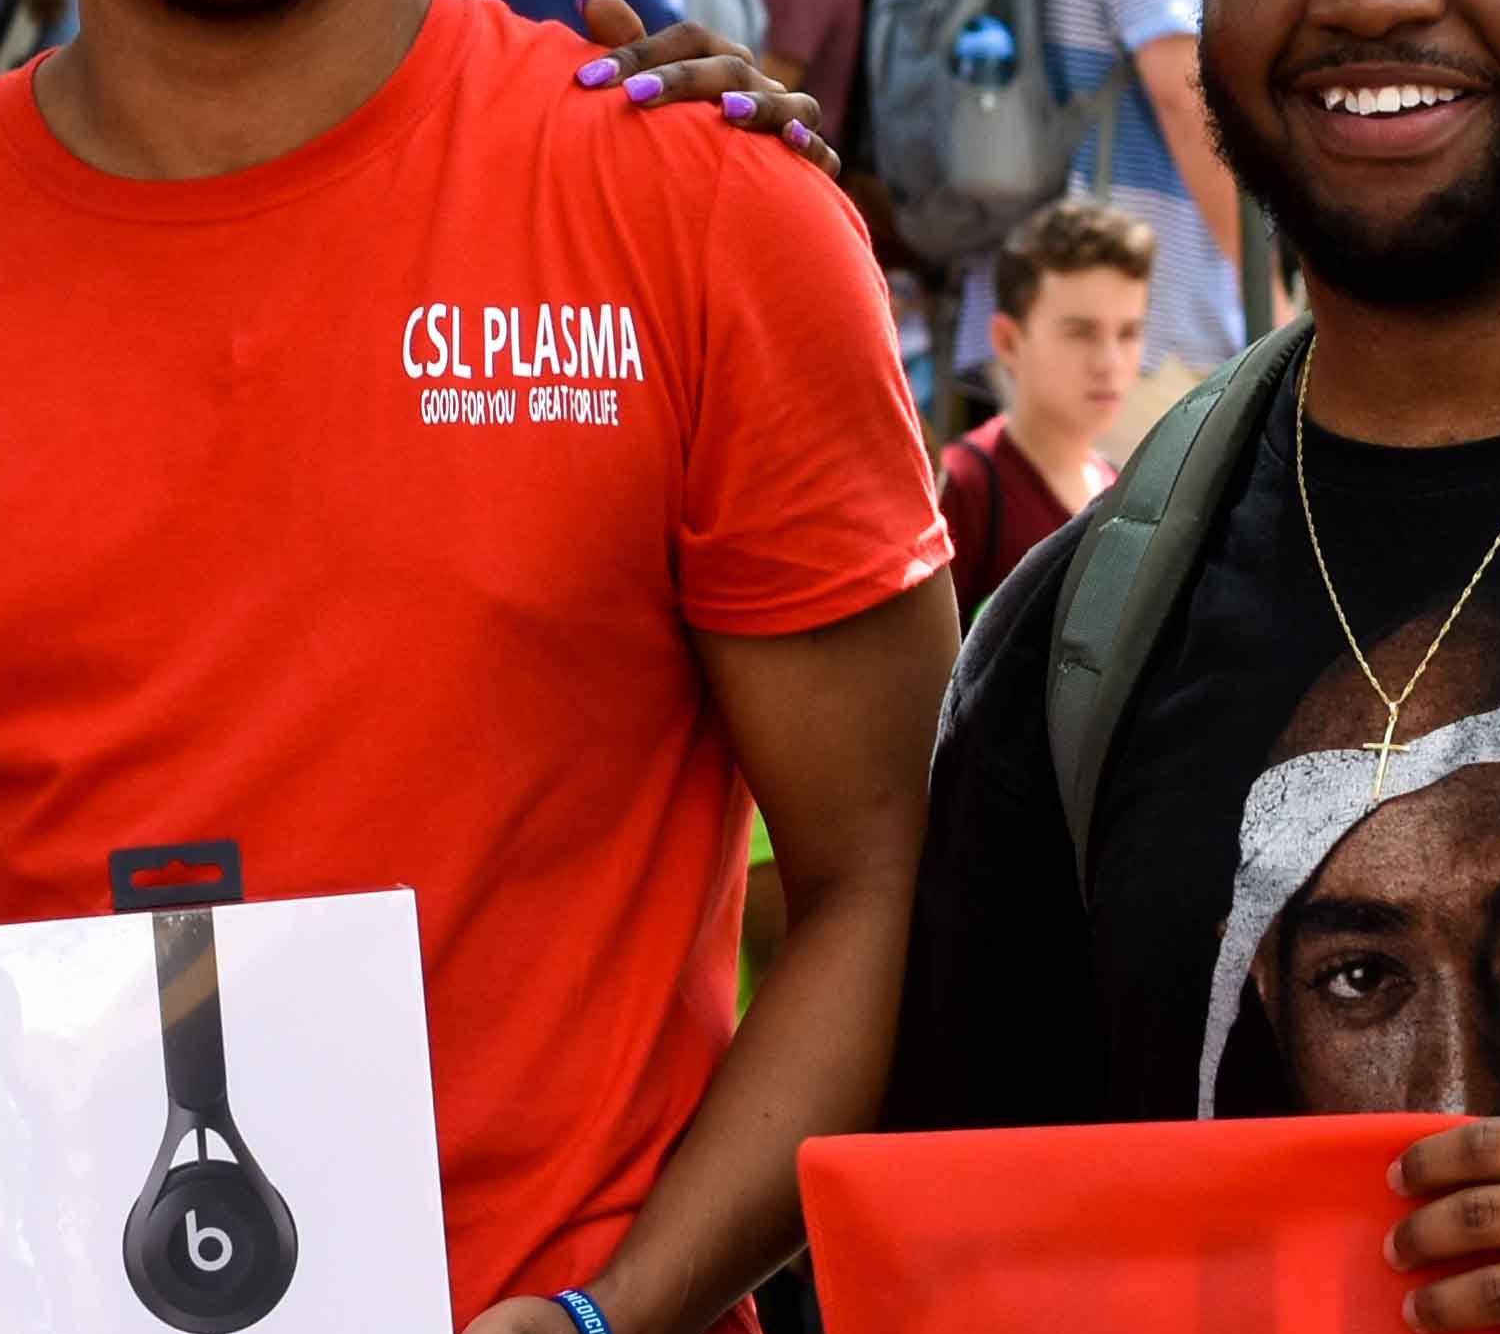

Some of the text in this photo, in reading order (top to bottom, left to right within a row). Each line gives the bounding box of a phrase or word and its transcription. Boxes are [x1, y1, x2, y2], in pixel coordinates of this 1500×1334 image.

[403, 303, 644, 381] CSL PLASMA
[421, 385, 618, 426] GOOD FOR YOU GREAT FOR LIFE
